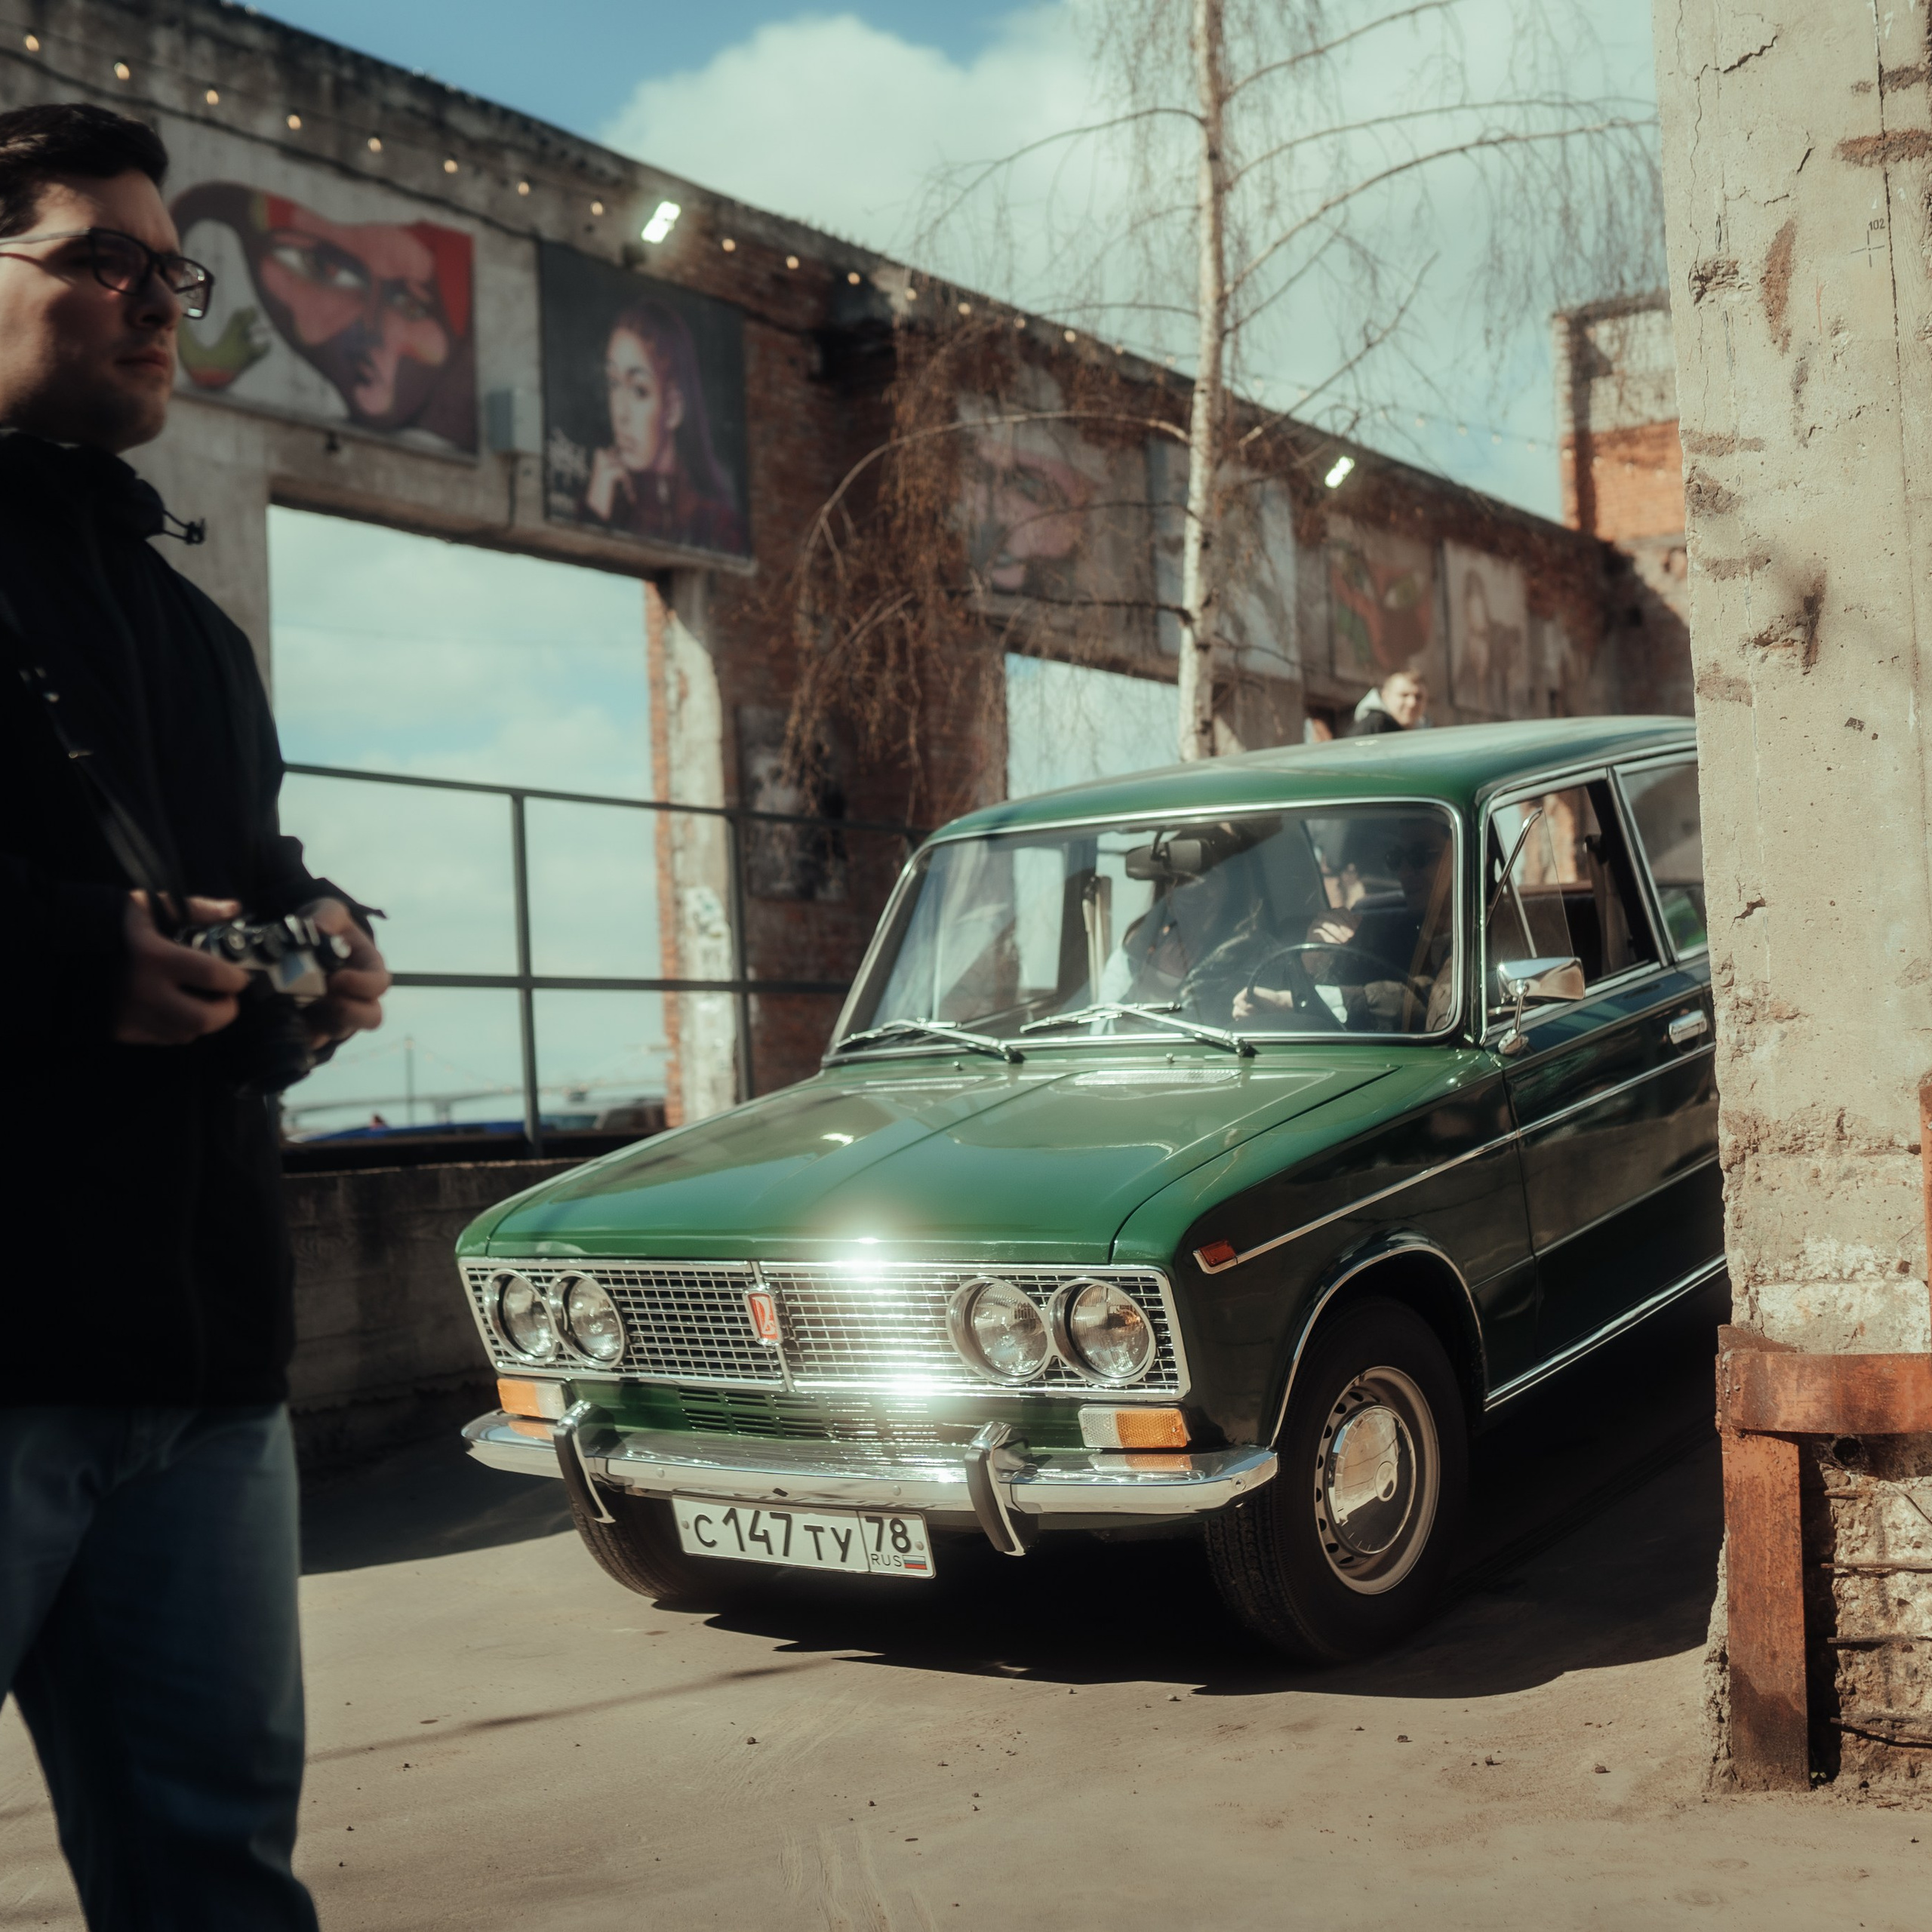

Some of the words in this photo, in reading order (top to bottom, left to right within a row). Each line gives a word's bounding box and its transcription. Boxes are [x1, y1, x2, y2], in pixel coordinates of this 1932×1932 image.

[1869, 217, 1885, 231] 102
[865, 1515, 911, 1554] 78
[870, 1553, 903, 1567] RUS
